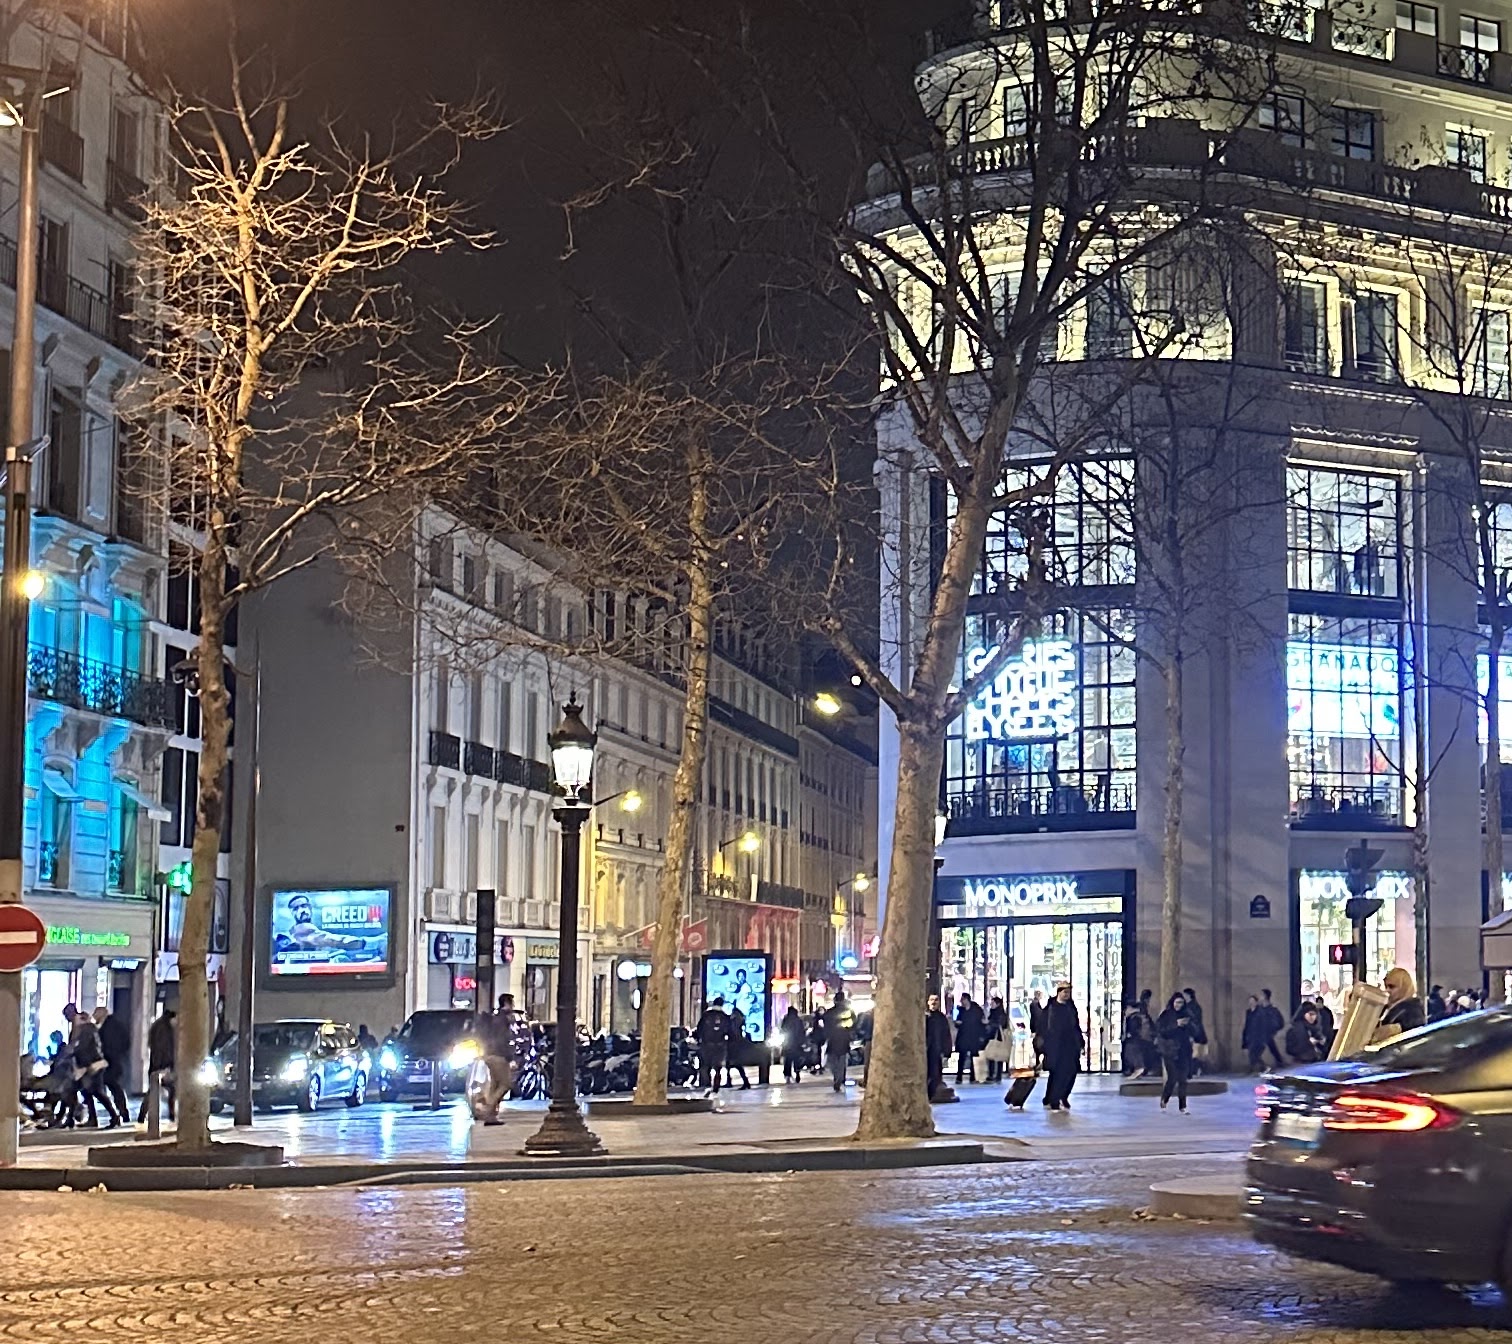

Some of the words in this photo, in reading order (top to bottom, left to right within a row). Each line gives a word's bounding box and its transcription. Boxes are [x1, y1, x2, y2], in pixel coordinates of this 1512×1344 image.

[964, 880, 1079, 907] MONOPRIX
[1299, 873, 1410, 900] MONRIX
[321, 905, 367, 923] CREED
